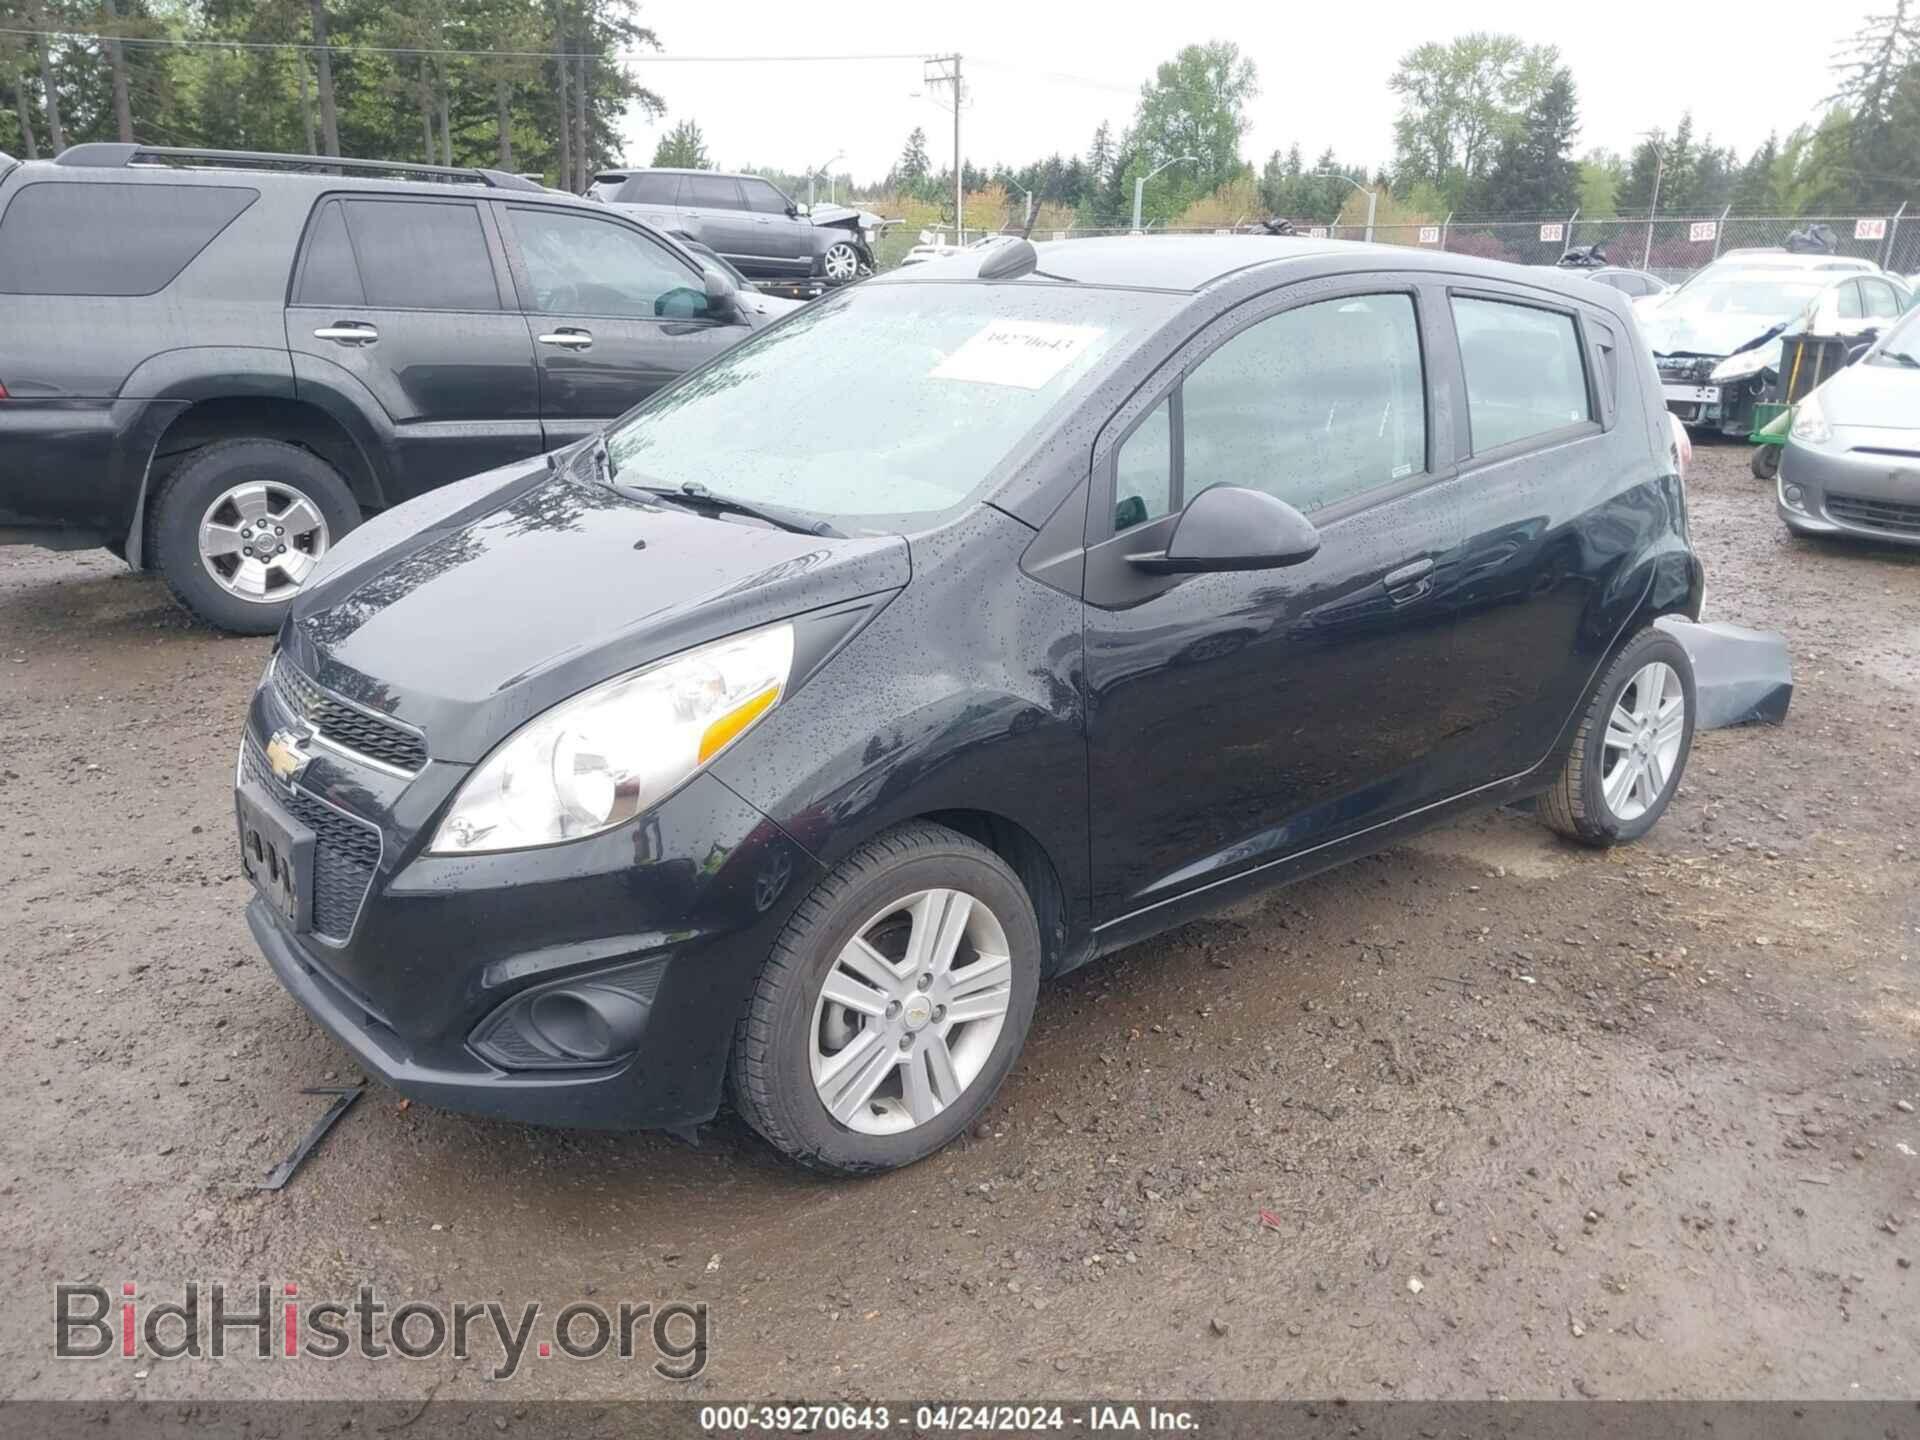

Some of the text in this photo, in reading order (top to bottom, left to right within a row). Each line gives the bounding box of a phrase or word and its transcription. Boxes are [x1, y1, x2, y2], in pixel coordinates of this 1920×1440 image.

[1421, 228, 1437, 240] SF7
[1542, 225, 1562, 240] SF6
[1692, 223, 1716, 239] SF5
[1857, 221, 1884, 238] SF4
